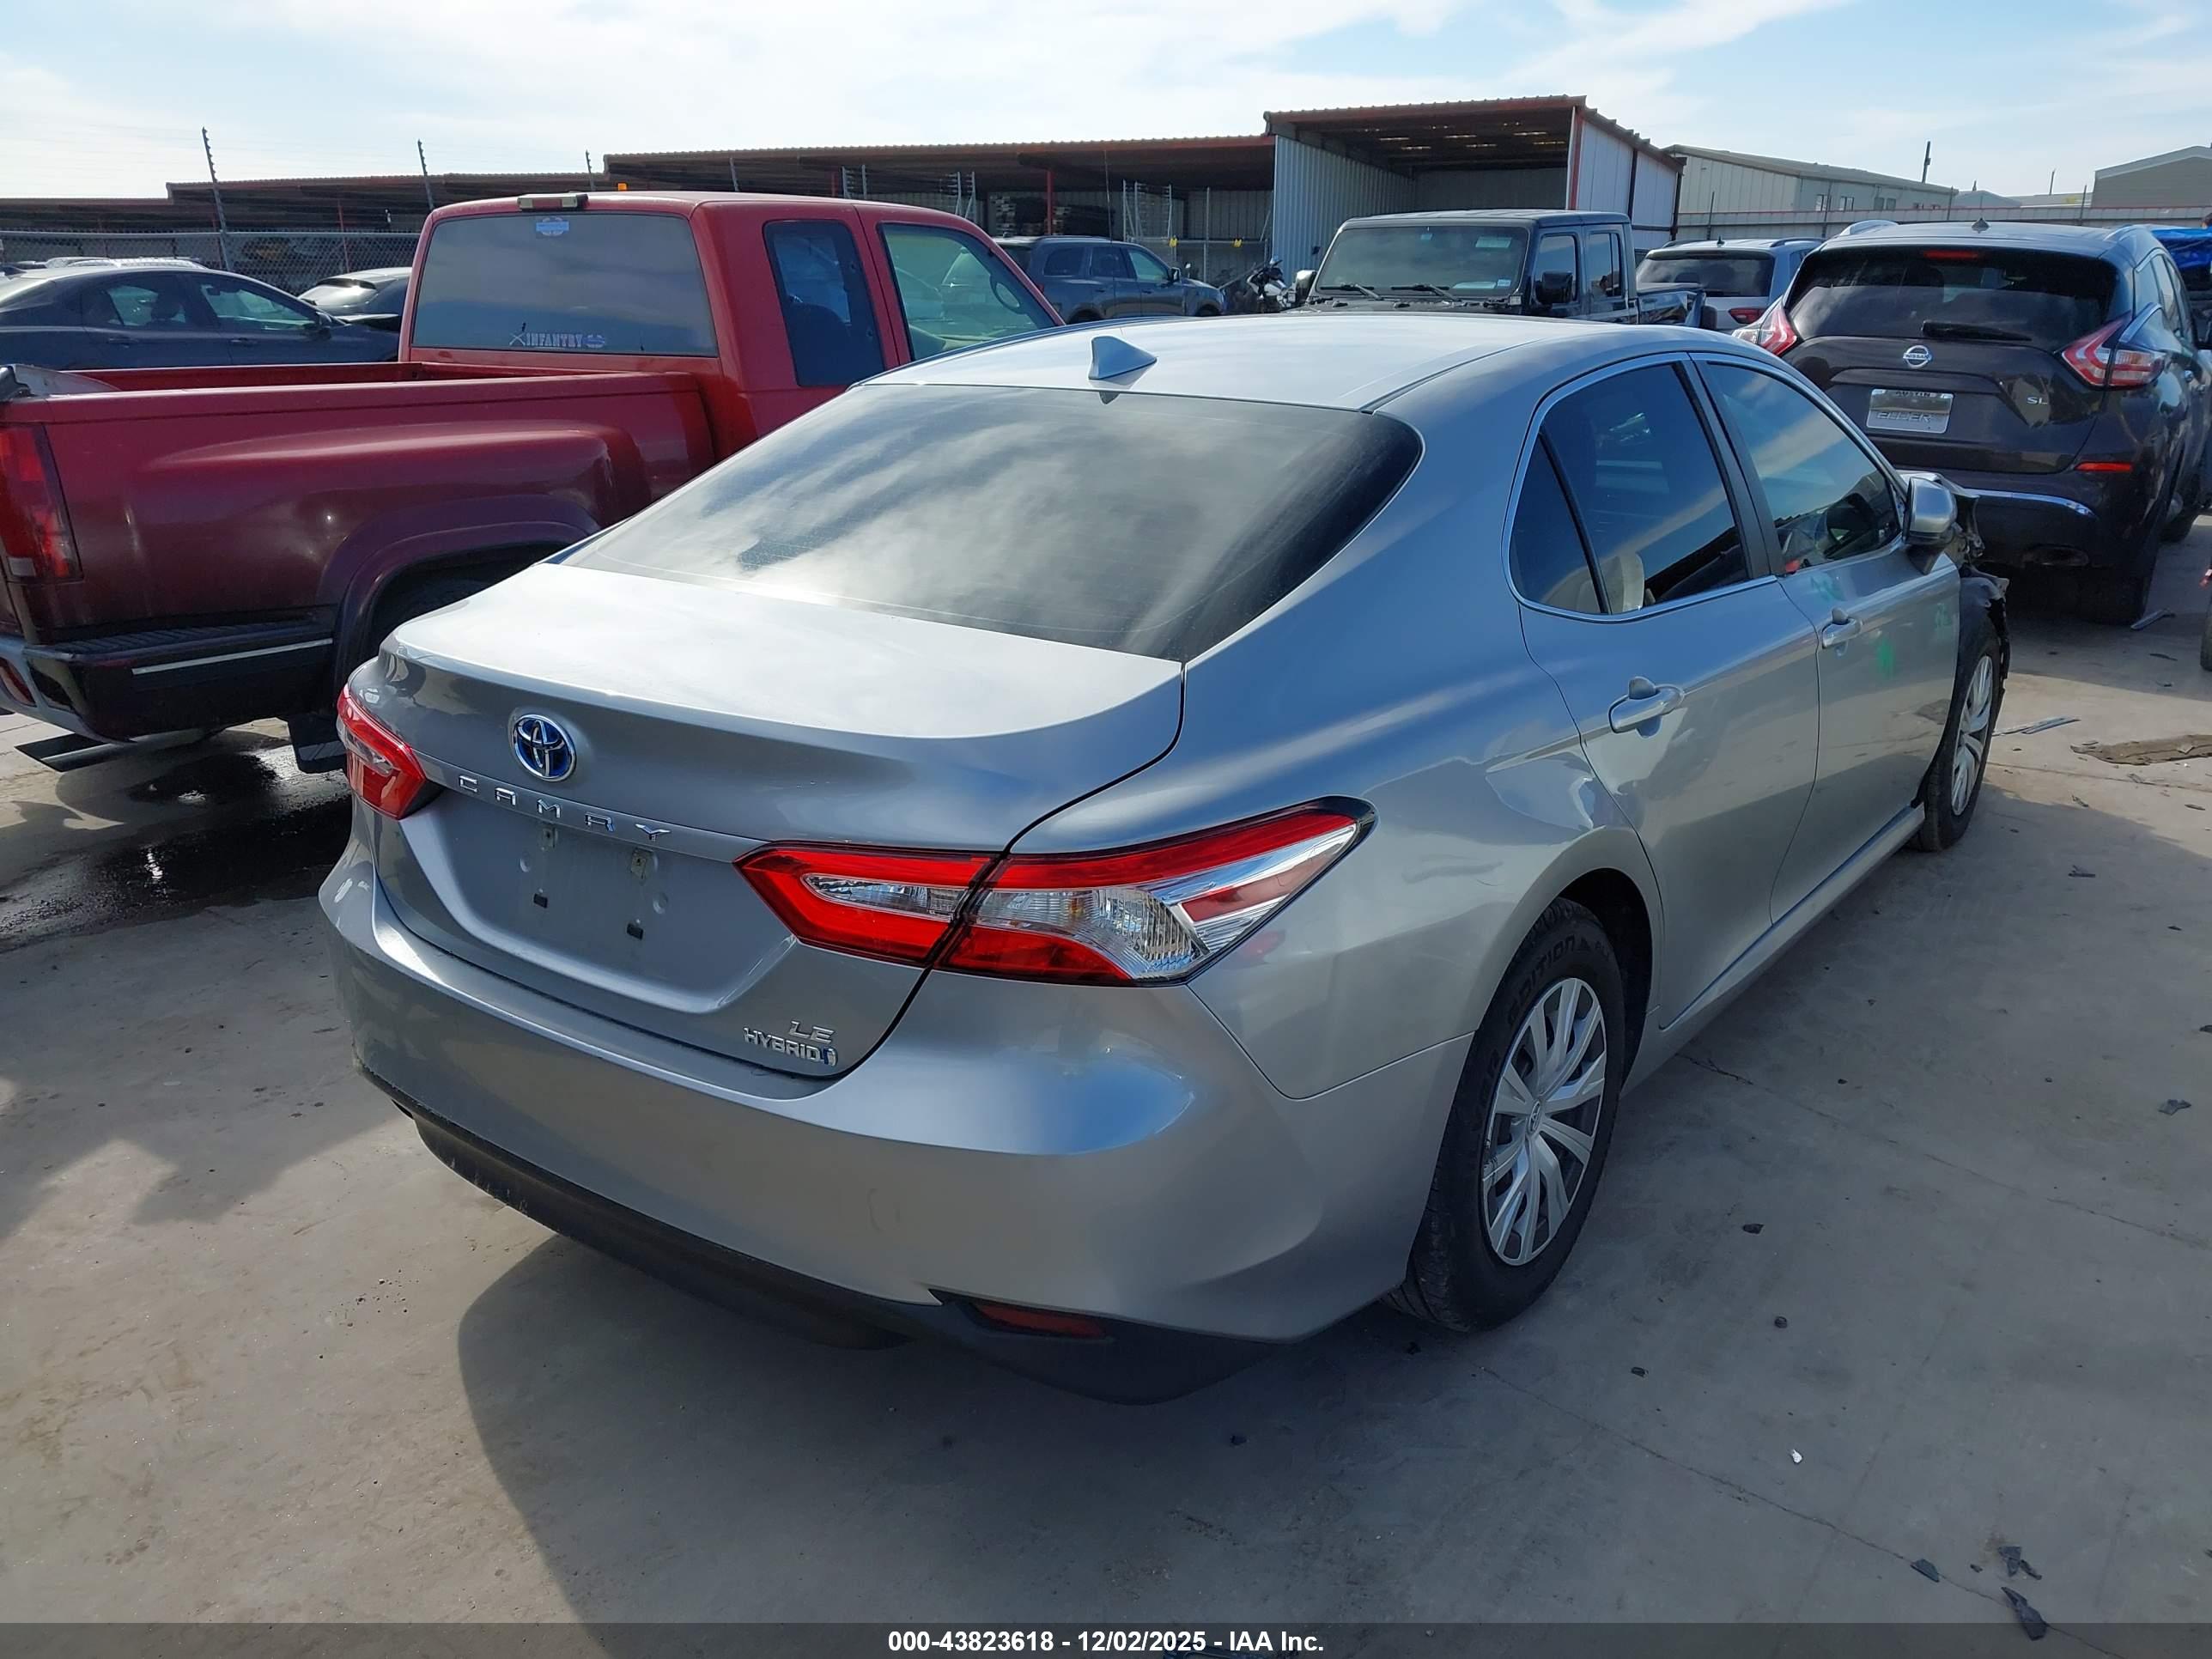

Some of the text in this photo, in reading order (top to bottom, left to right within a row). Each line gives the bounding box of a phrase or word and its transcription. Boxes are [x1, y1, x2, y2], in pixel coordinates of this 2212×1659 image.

[526, 332, 583, 348] INFANTRY
[2026, 396, 2048, 405] SL
[458, 775, 672, 842] CAMRY
[789, 1020, 835, 1044] LE
[743, 1027, 822, 1062] HYBRID
